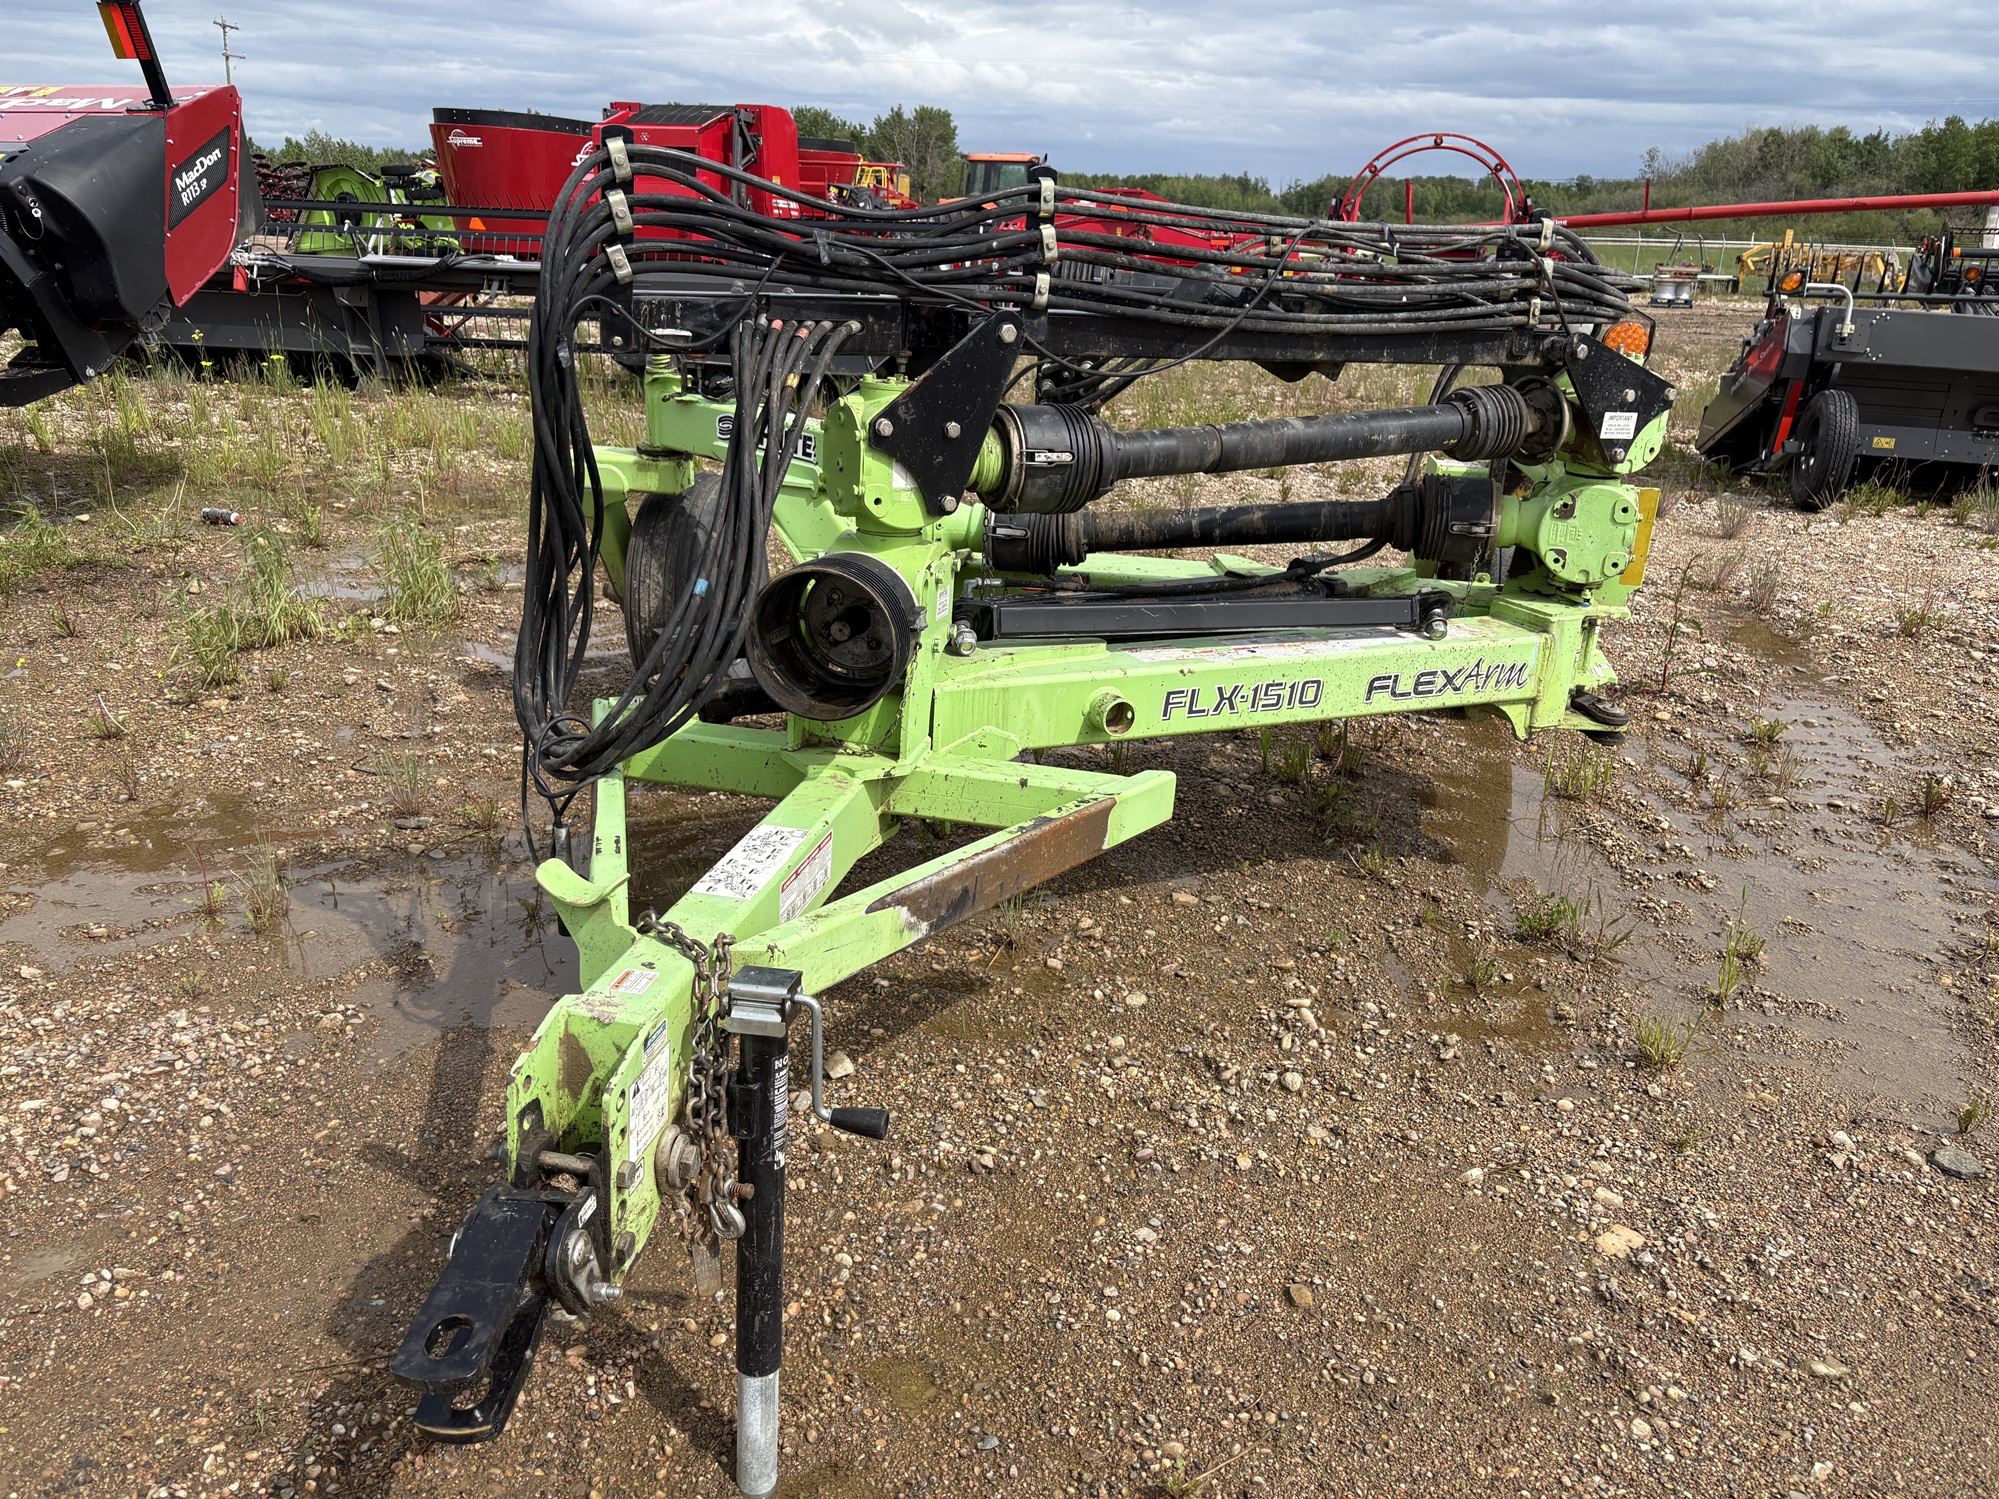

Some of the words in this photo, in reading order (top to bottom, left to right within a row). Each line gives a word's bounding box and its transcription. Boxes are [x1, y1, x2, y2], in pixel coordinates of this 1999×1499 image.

[175, 148, 221, 192] MacDon
[181, 181, 201, 206] R113
[1161, 678, 1324, 720] FLX-1510
